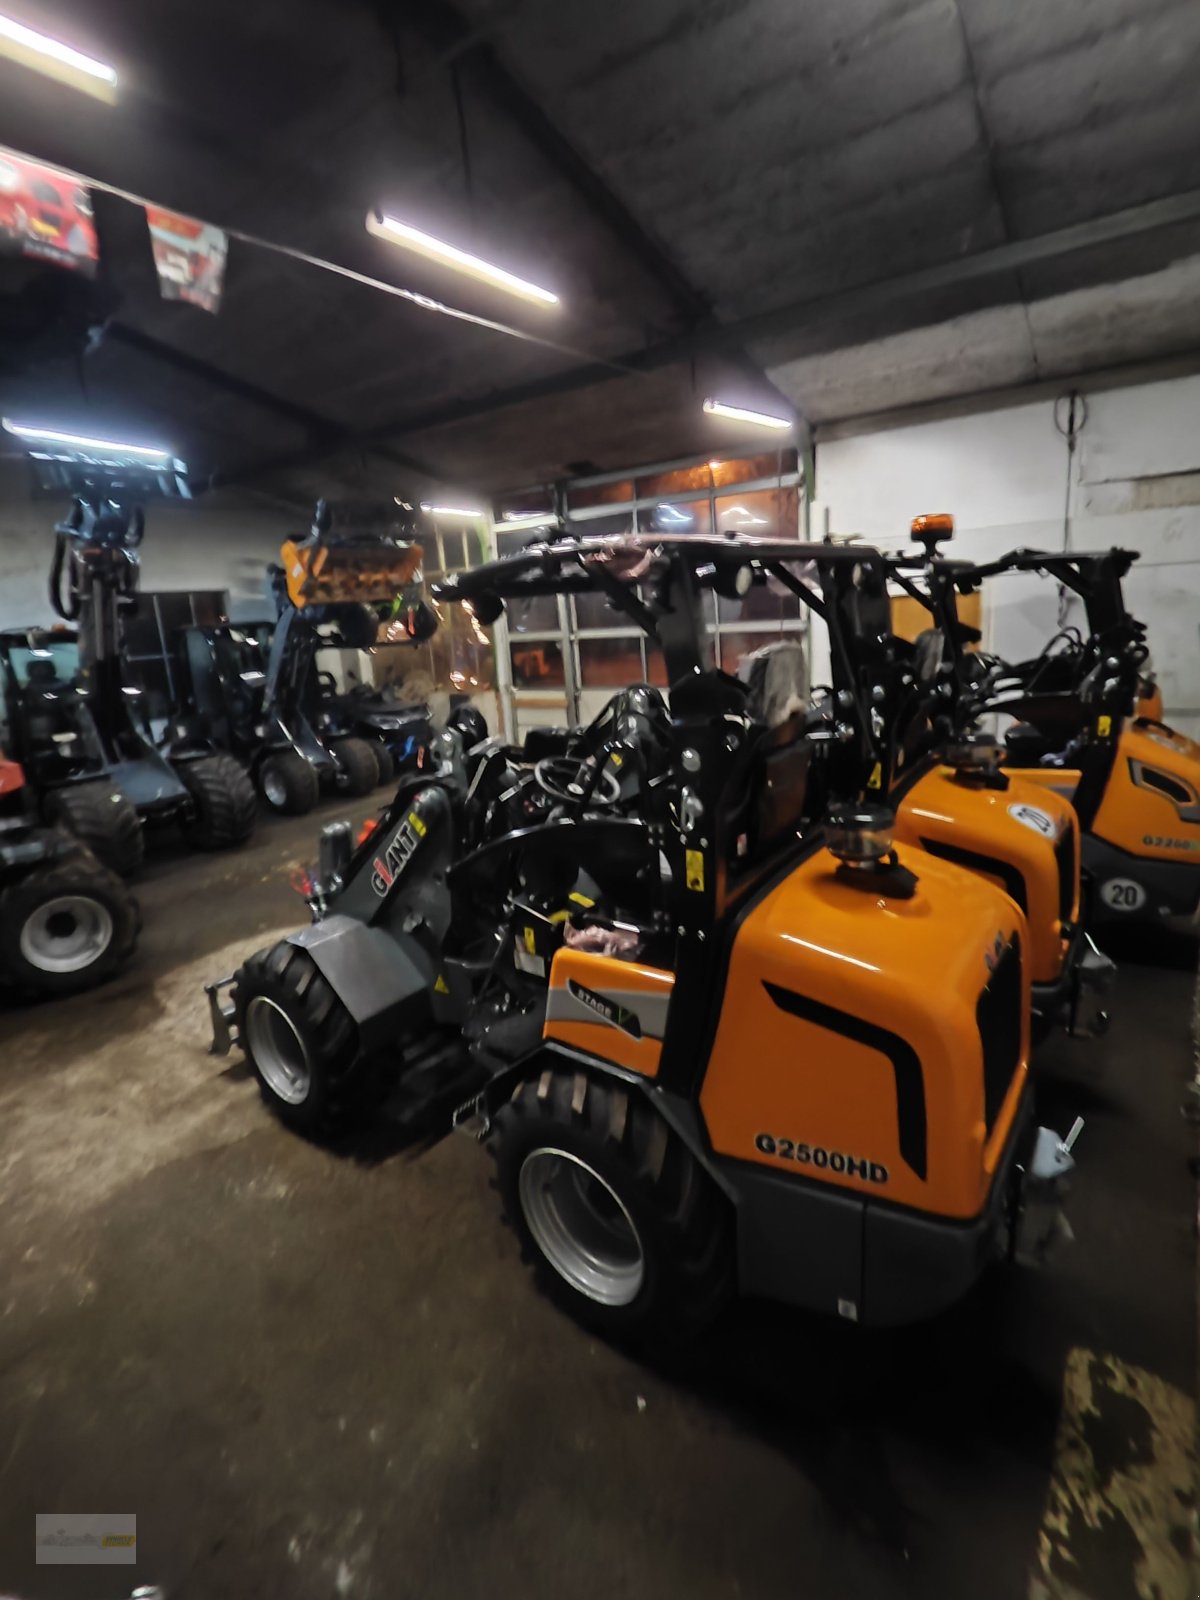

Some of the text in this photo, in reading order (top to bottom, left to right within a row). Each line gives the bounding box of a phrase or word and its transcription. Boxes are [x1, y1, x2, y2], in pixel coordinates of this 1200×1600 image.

[371, 821, 417, 897] GIANT
[1112, 885, 1138, 906] 20
[577, 988, 613, 1019] STAGE
[754, 1133, 889, 1184] G2500HD
